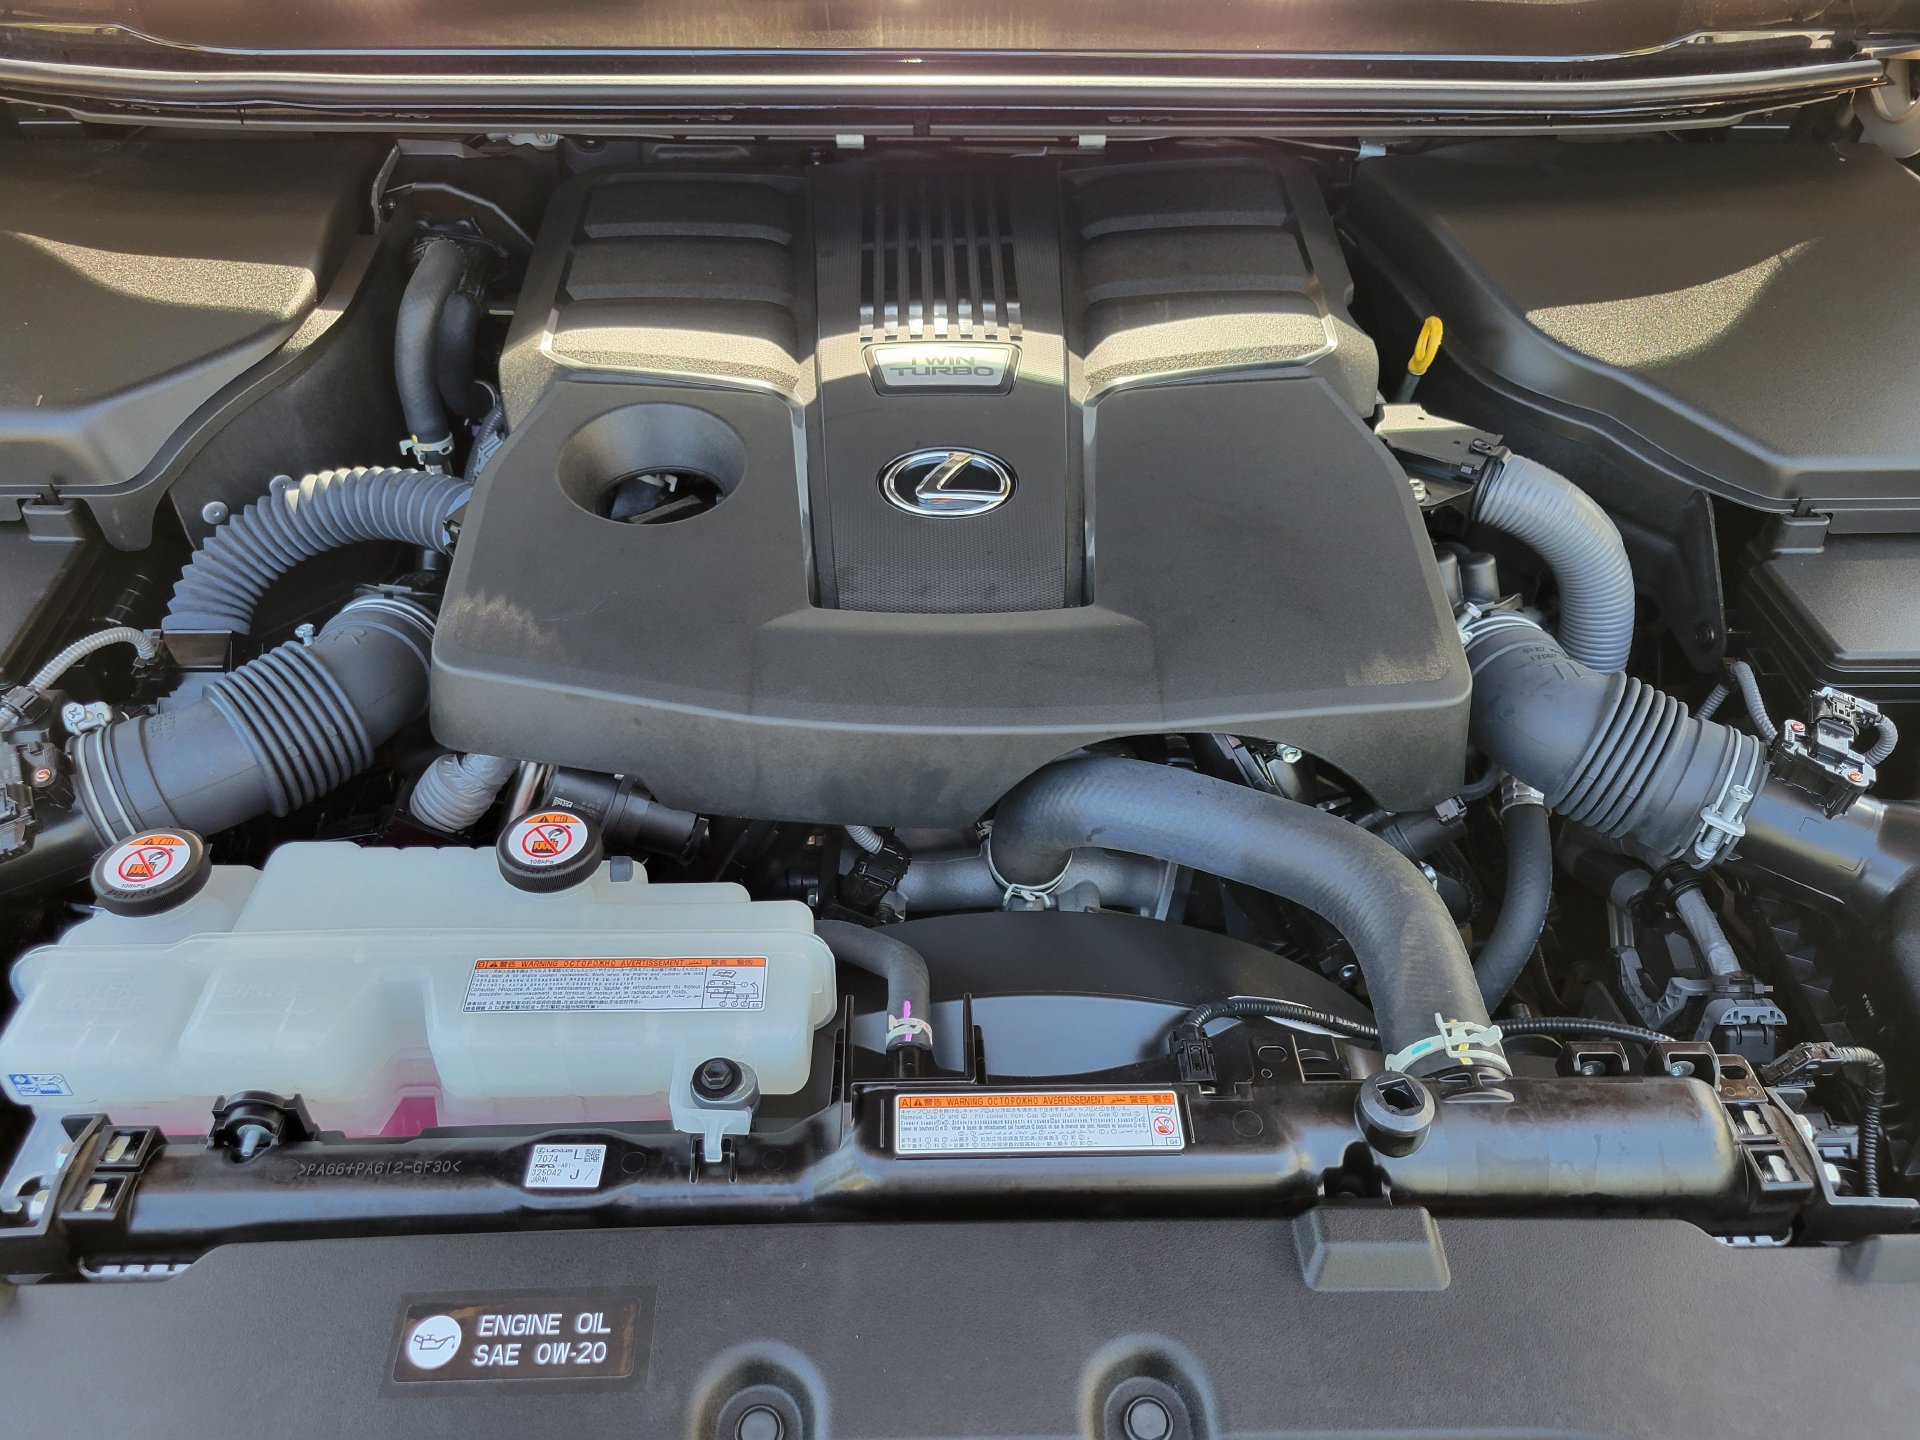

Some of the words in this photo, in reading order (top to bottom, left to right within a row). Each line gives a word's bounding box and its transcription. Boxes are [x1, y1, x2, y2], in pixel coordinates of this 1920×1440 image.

[890, 366, 994, 376] TURBO
[946, 1098, 984, 1106] WARNING
[988, 1096, 1038, 1105] ОСТОРОЖНО
[1042, 1095, 1105, 1105] AVERTISSEMENT
[537, 1154, 559, 1163] 7074
[573, 1149, 583, 1160] L
[531, 1168, 562, 1176] 325042
[569, 1168, 580, 1180] J
[477, 1313, 563, 1337] ENGINE
[575, 1312, 611, 1335] OIL
[471, 1343, 522, 1368] SAE
[533, 1341, 607, 1365] 0W-20
